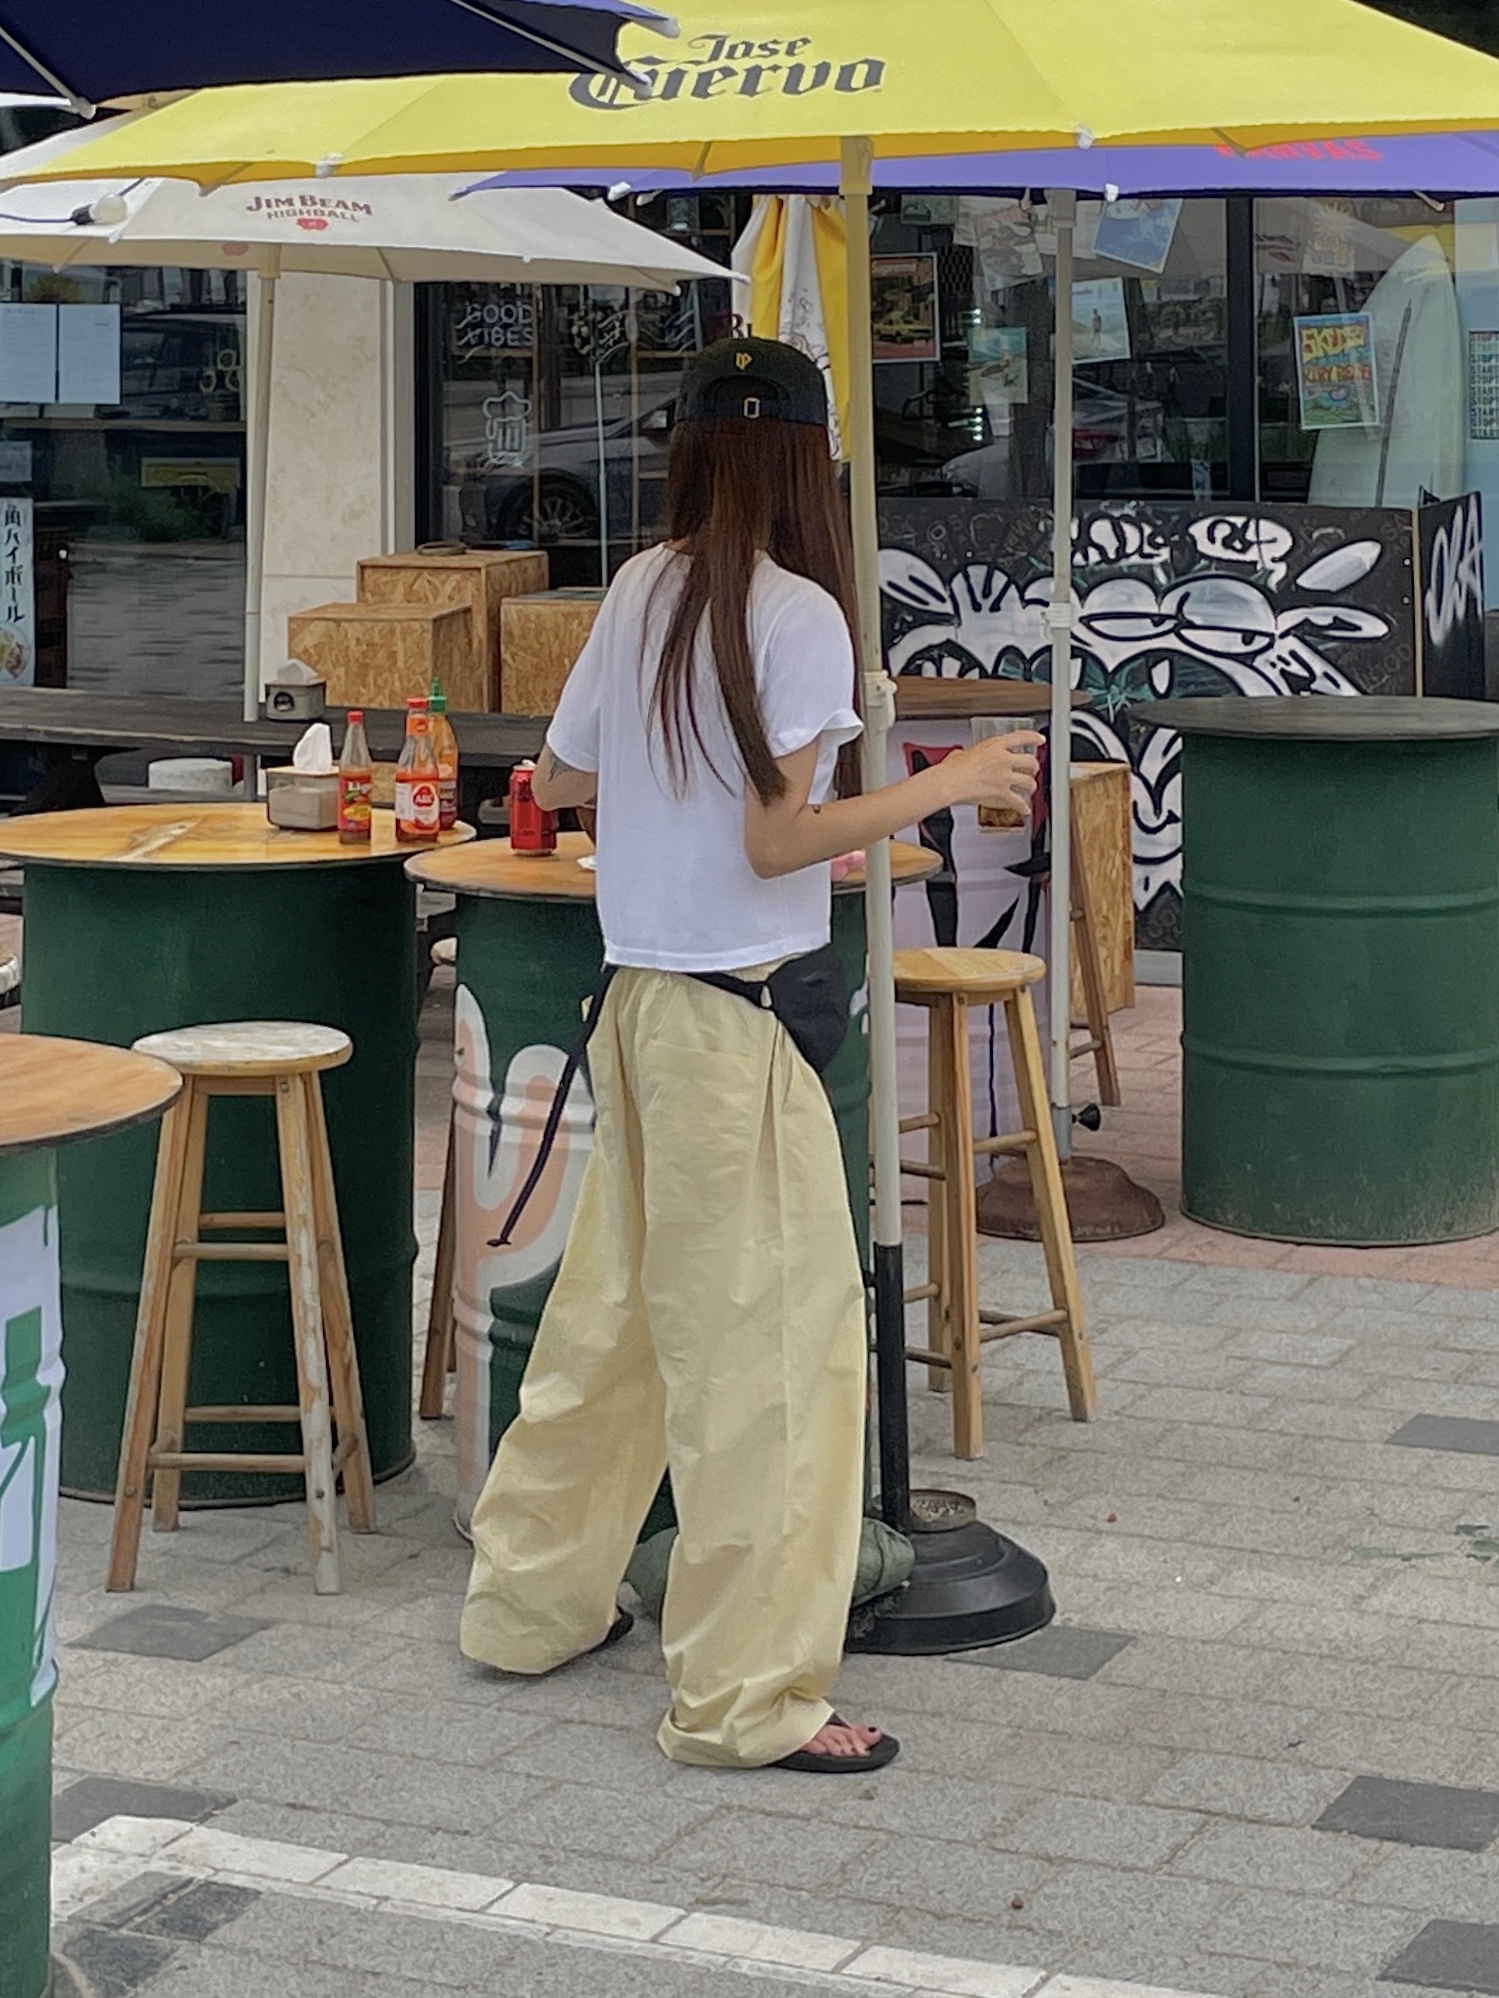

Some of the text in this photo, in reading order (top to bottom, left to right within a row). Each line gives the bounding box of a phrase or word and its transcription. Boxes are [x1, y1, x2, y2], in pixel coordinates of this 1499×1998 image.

[688, 34, 812, 63] Jose
[568, 56, 886, 111] Cuervo
[246, 195, 373, 216] JIM BEAM
[466, 303, 533, 323] GOOD
